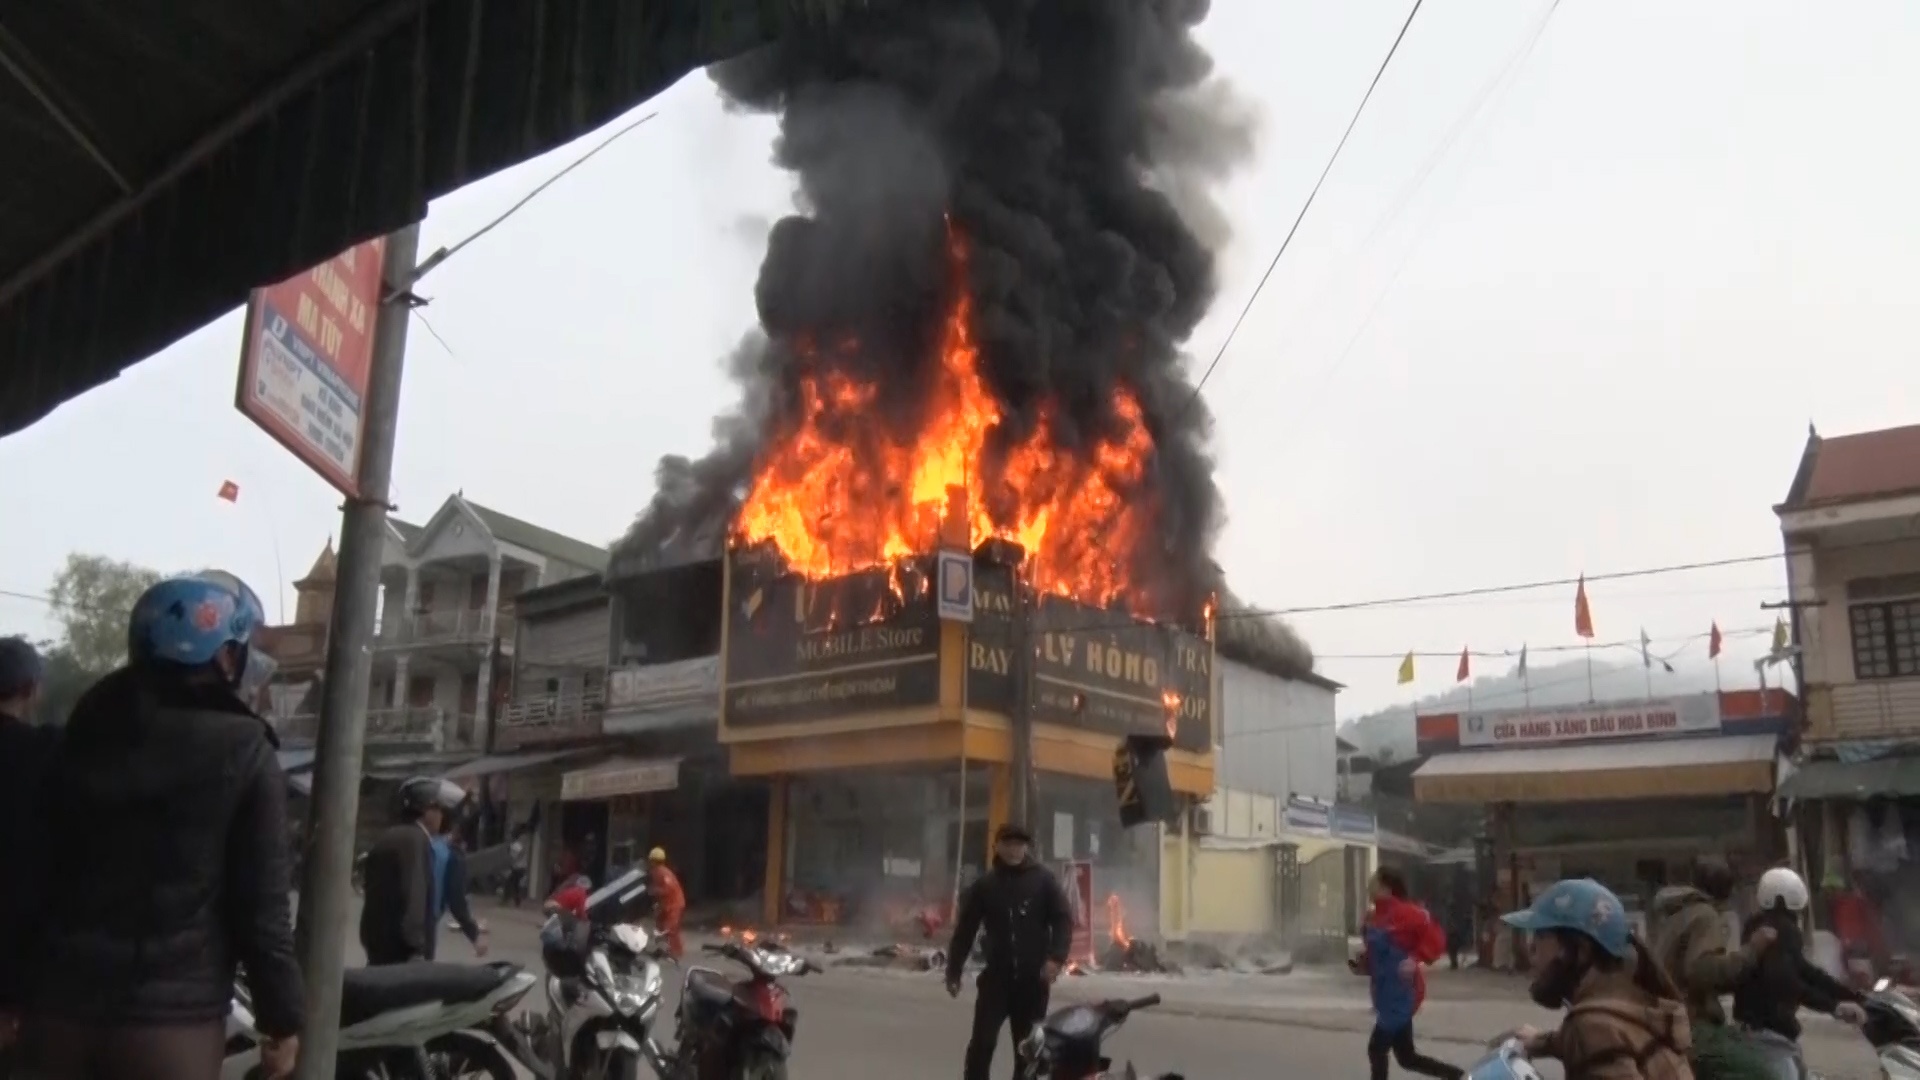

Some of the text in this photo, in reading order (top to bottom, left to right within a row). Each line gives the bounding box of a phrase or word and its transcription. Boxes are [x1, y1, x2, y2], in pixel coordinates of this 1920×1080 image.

[296, 292, 319, 338] MA
[796, 626, 924, 661] MOBILE Store
[970, 638, 1014, 676] BAY
